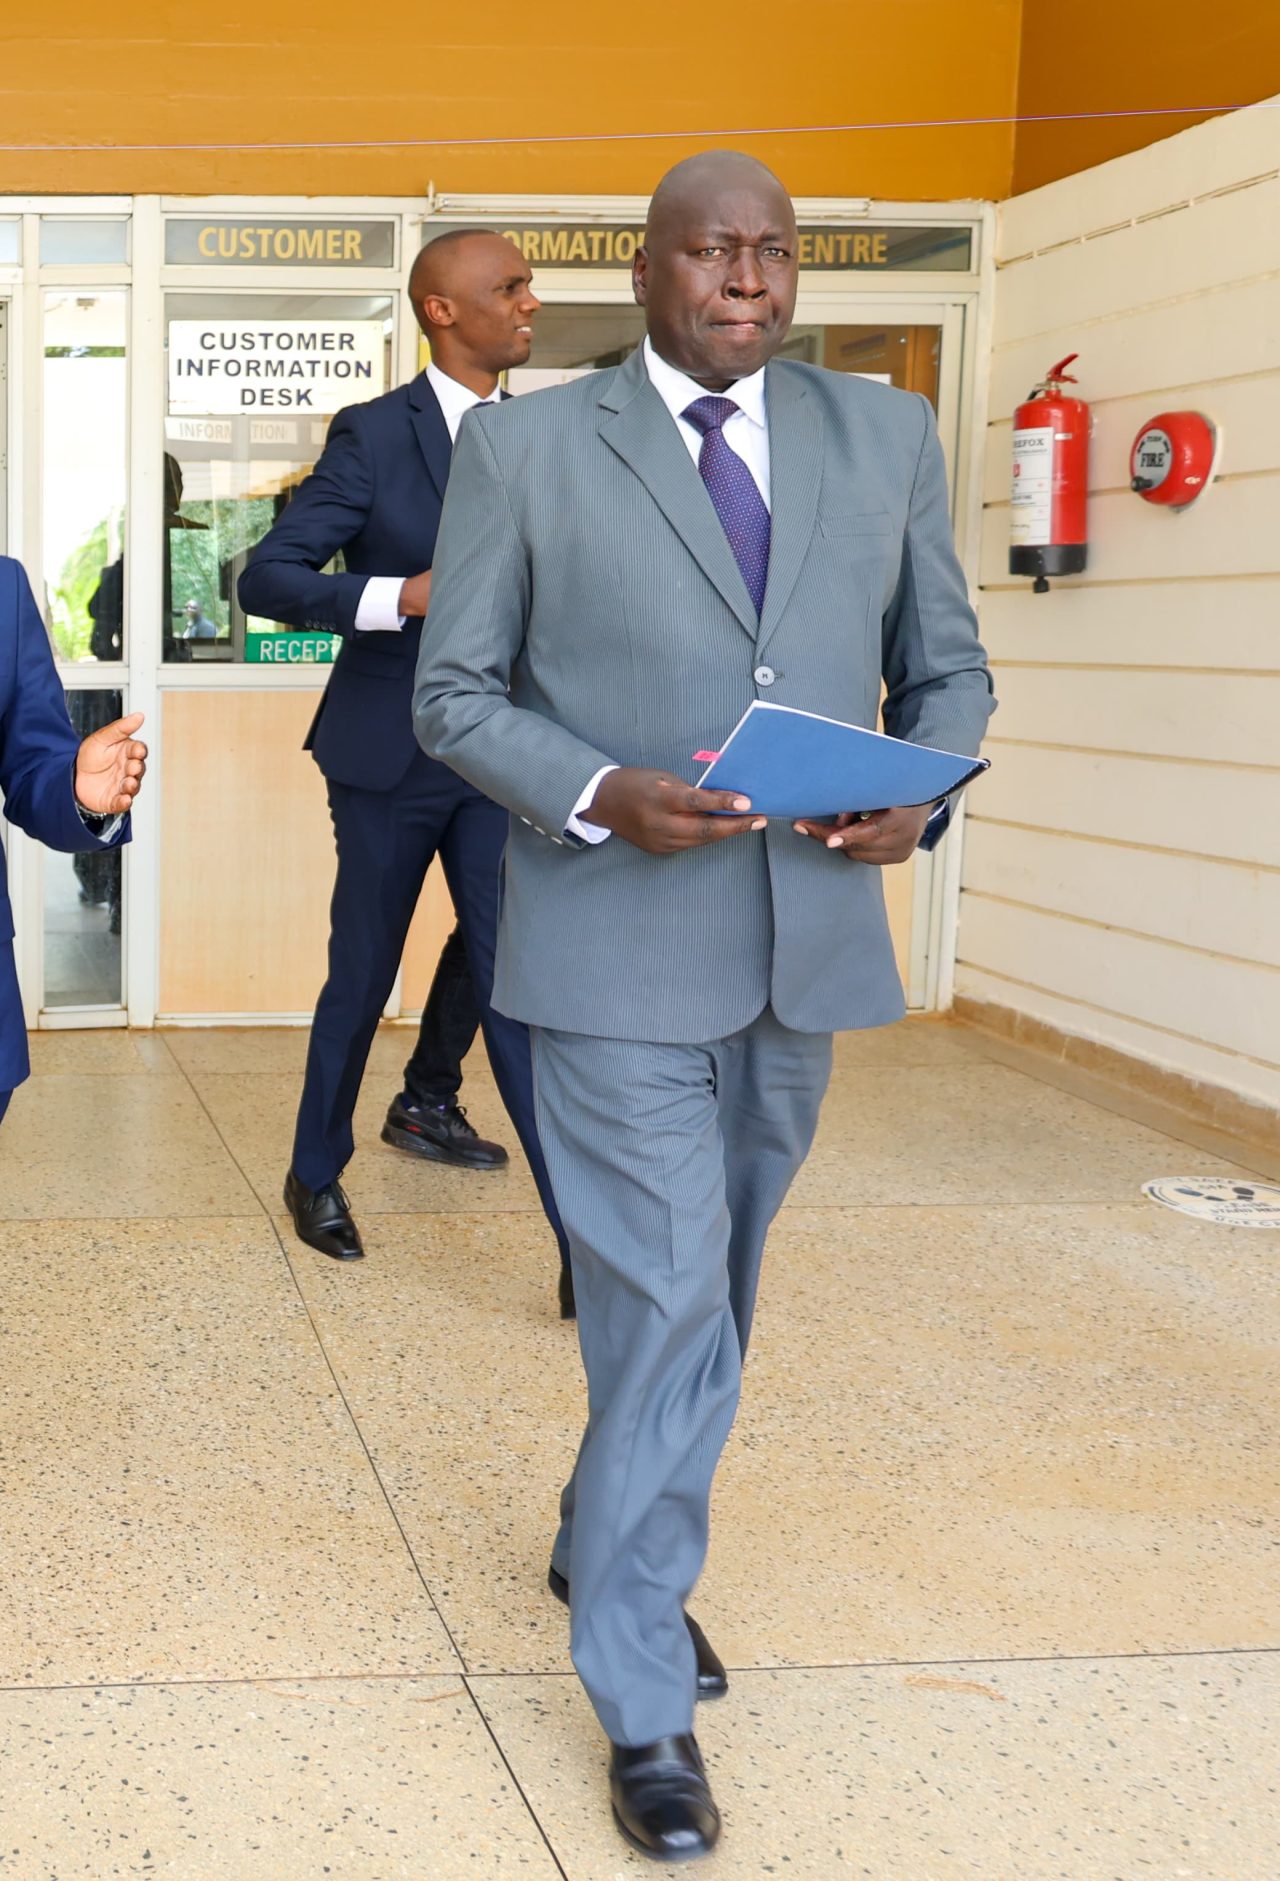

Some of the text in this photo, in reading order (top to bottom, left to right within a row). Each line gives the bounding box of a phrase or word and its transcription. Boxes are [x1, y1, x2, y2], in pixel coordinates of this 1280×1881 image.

[198, 227, 362, 259] CUSTOMER
[503, 230, 888, 264] RMATIO ENTRE
[199, 332, 356, 352] CUSTOMER
[175, 358, 373, 379] INFORMATION
[240, 388, 314, 407] DESK
[1140, 452, 1165, 468] FIRE
